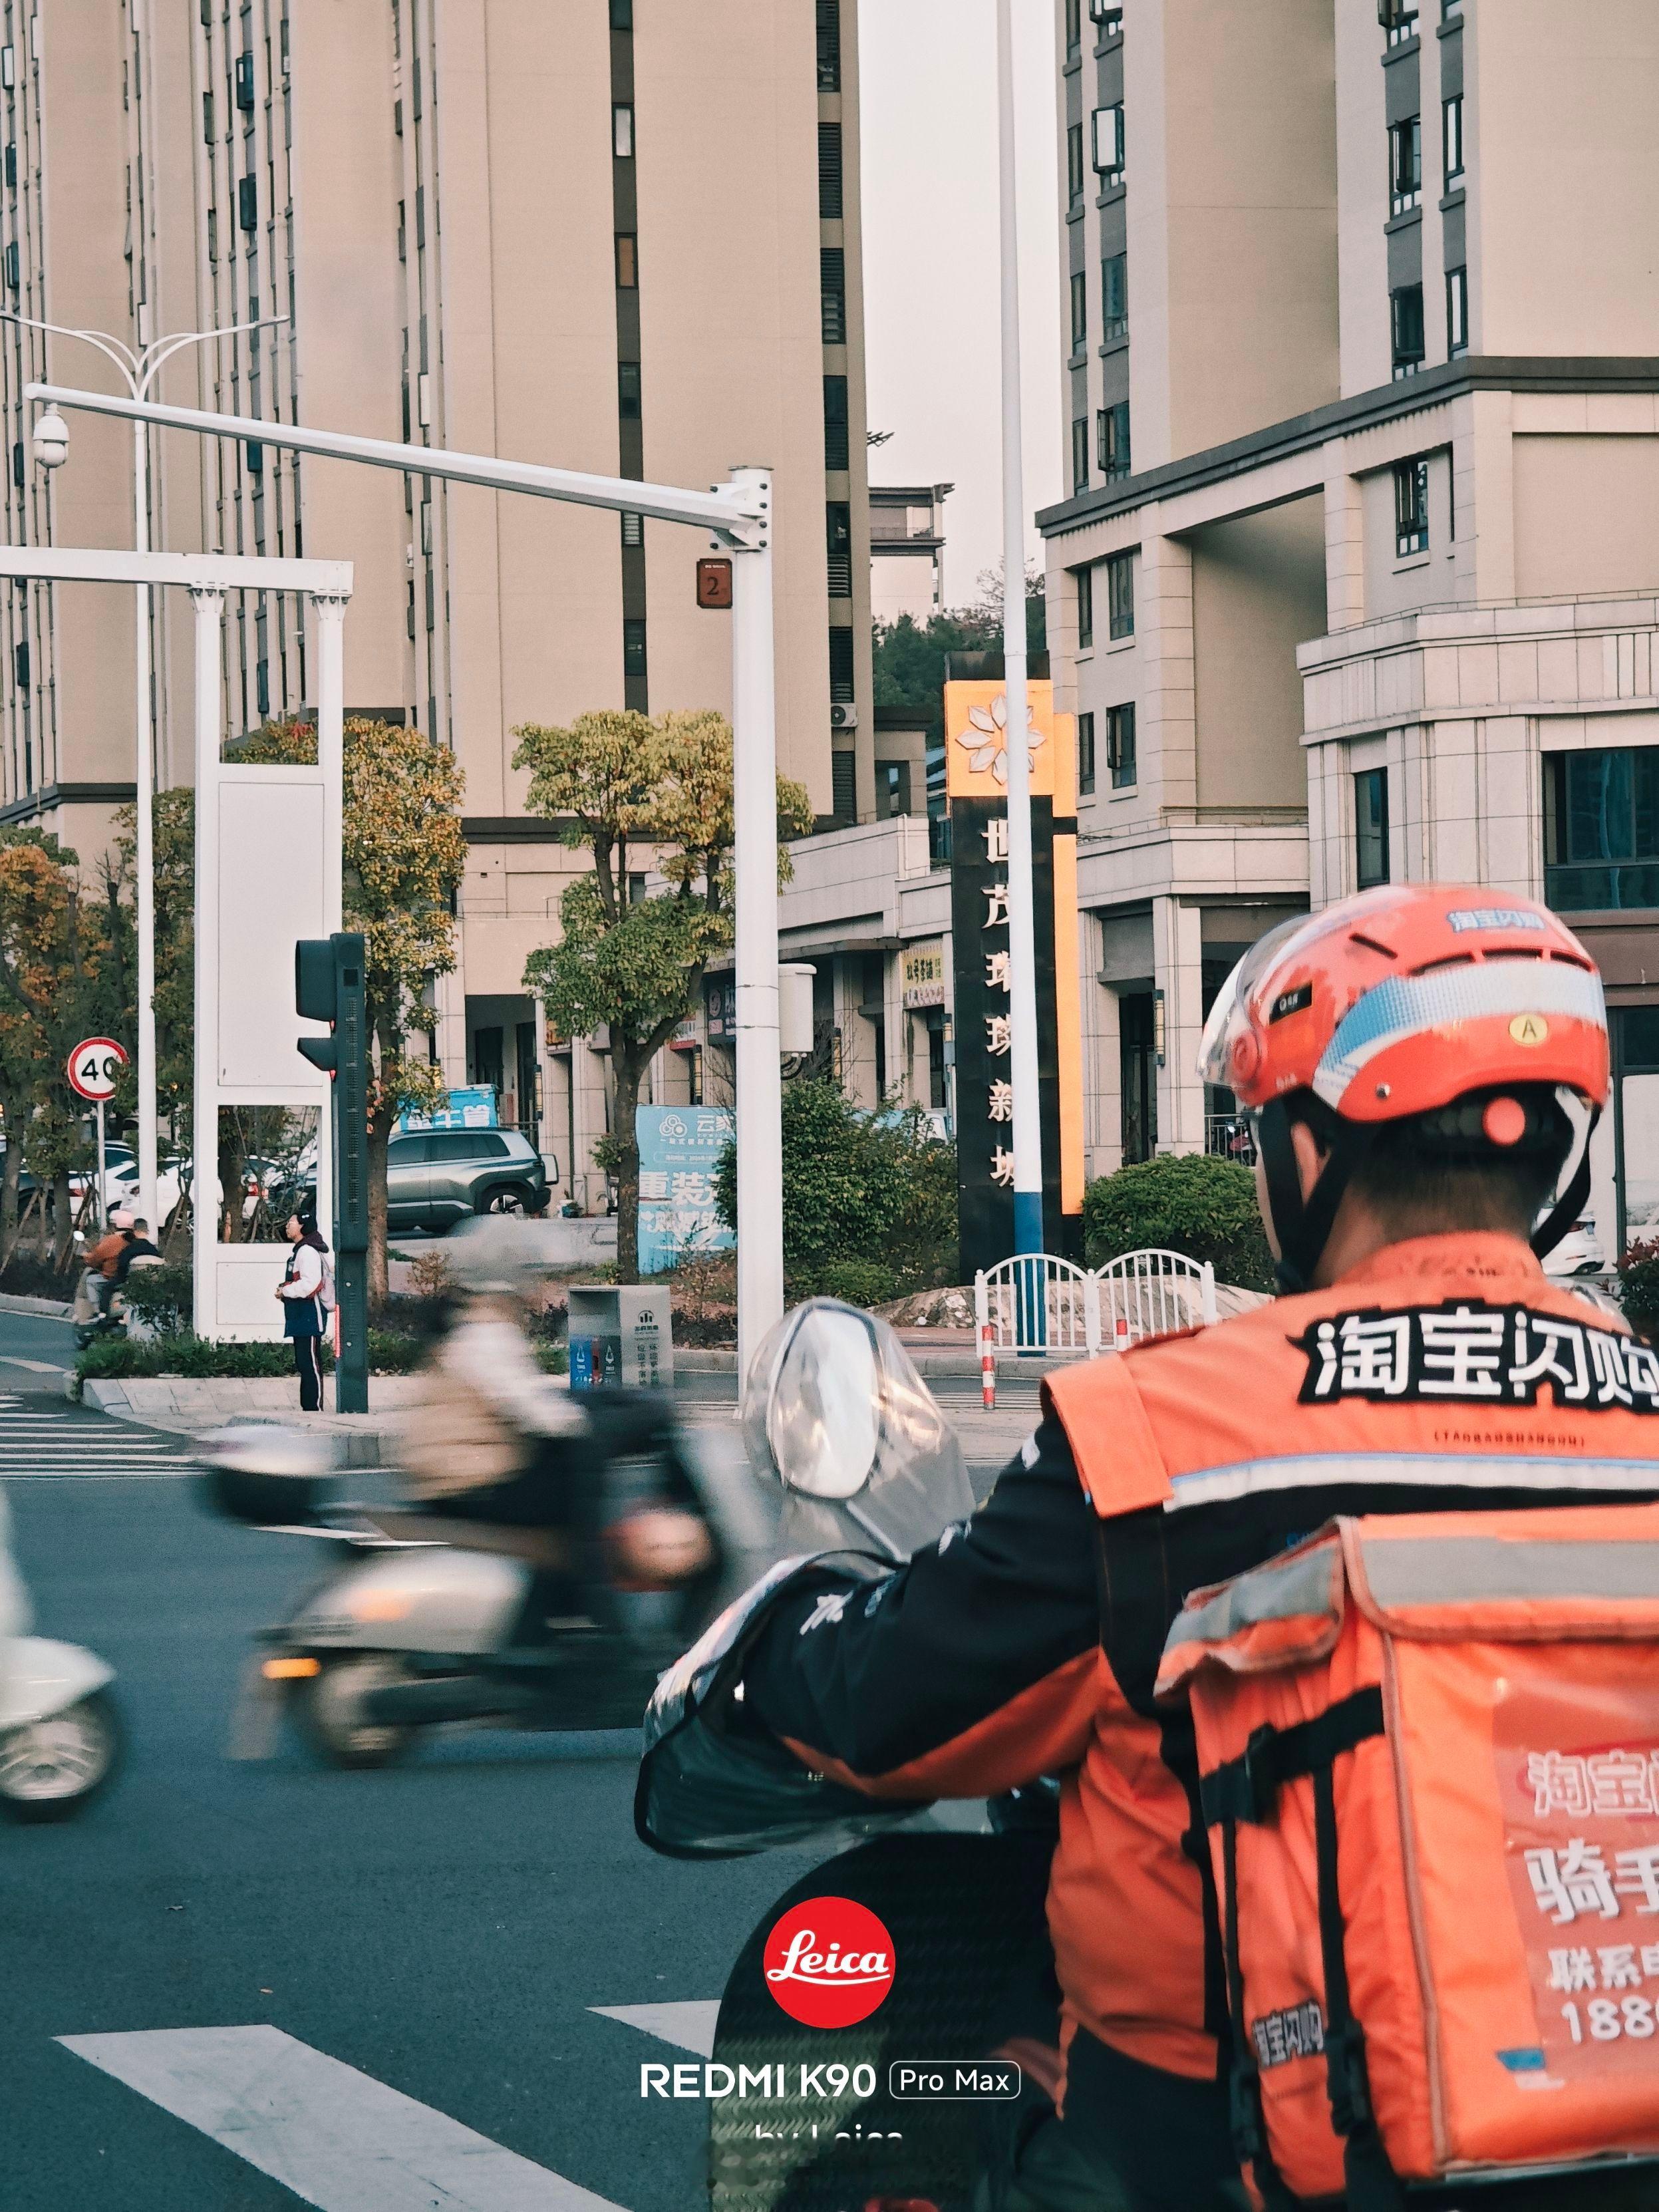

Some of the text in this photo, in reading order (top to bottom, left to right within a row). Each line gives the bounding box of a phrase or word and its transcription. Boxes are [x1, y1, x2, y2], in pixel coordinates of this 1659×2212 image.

[707, 576, 719, 595] 2
[1522, 1019, 1537, 1038] A
[1314, 1305, 1659, 1406] 淘宝闪购
[1527, 1749, 1659, 1817] 淘宝
[1561, 1994, 1659, 2045] 188
